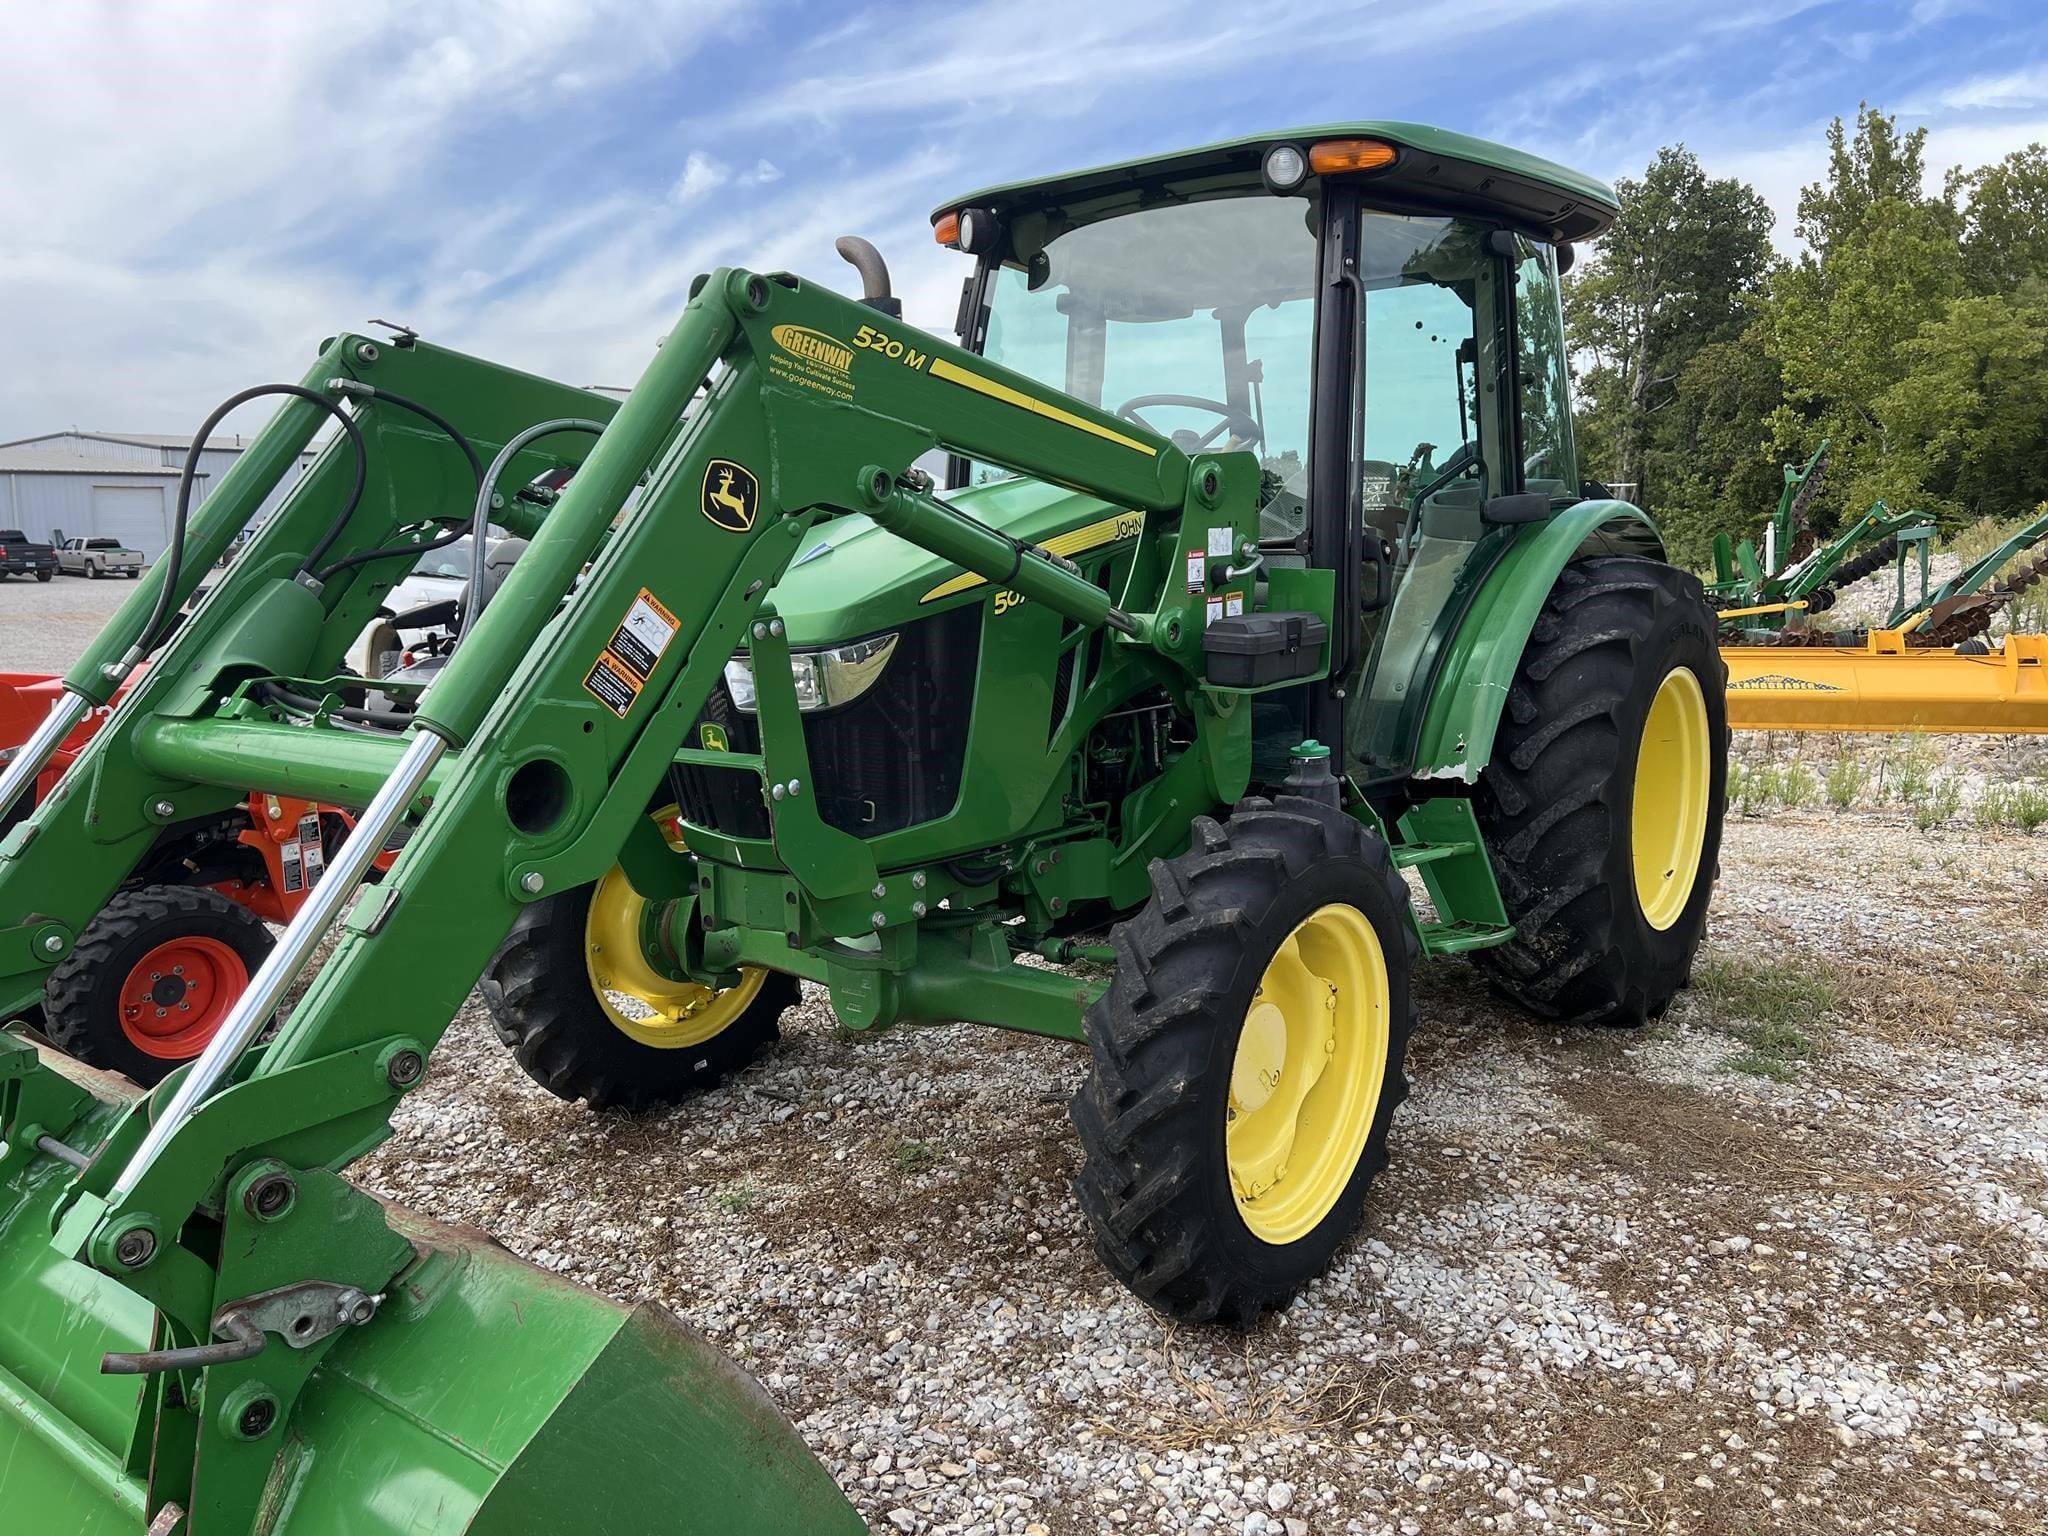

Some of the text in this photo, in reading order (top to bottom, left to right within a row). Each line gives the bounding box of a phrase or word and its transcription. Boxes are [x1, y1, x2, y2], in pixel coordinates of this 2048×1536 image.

[782, 327, 854, 370] GREENWAY
[852, 325, 927, 370] 520 M
[769, 353, 856, 391] Helping You Cultivate Success
[769, 366, 854, 402] www.gogreenway.com
[1115, 517, 1143, 540] JOHN
[649, 600, 676, 626] WARNING
[994, 590, 1026, 616] 50
[611, 663, 638, 689] WARNING
